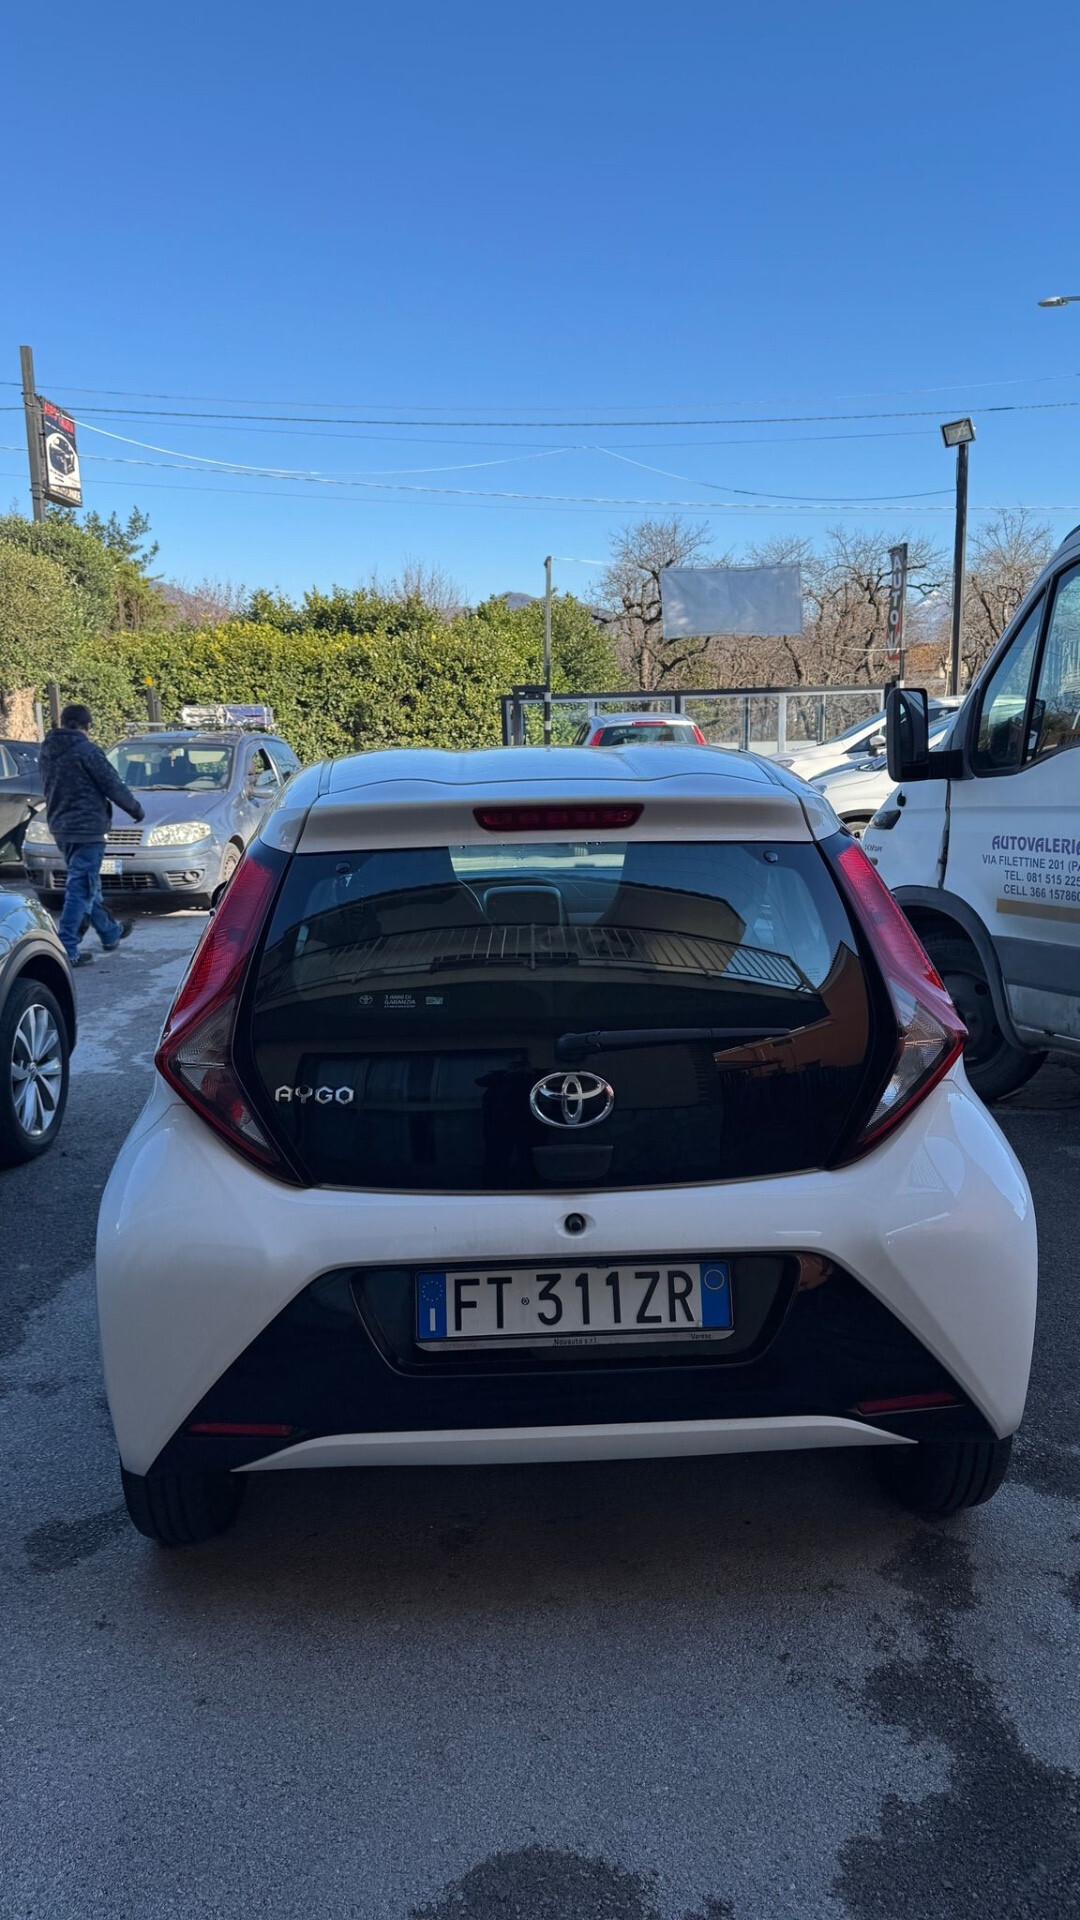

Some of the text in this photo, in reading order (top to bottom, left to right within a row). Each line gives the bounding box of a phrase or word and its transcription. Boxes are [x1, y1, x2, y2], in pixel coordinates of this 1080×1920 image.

[982, 854, 997, 865] VIA
[999, 856, 1046, 869] FILETTINE
[1048, 860, 1064, 871] 201
[1005, 870, 1024, 882] TEL.
[1027, 872, 1042, 883] 081
[1045, 874, 1062, 885] 515
[1004, 884, 1028, 896] CELL
[1030, 887, 1046, 898] 366
[275, 1085, 354, 1105] AYGO
[454, 1271, 694, 1331] FT 311ZR
